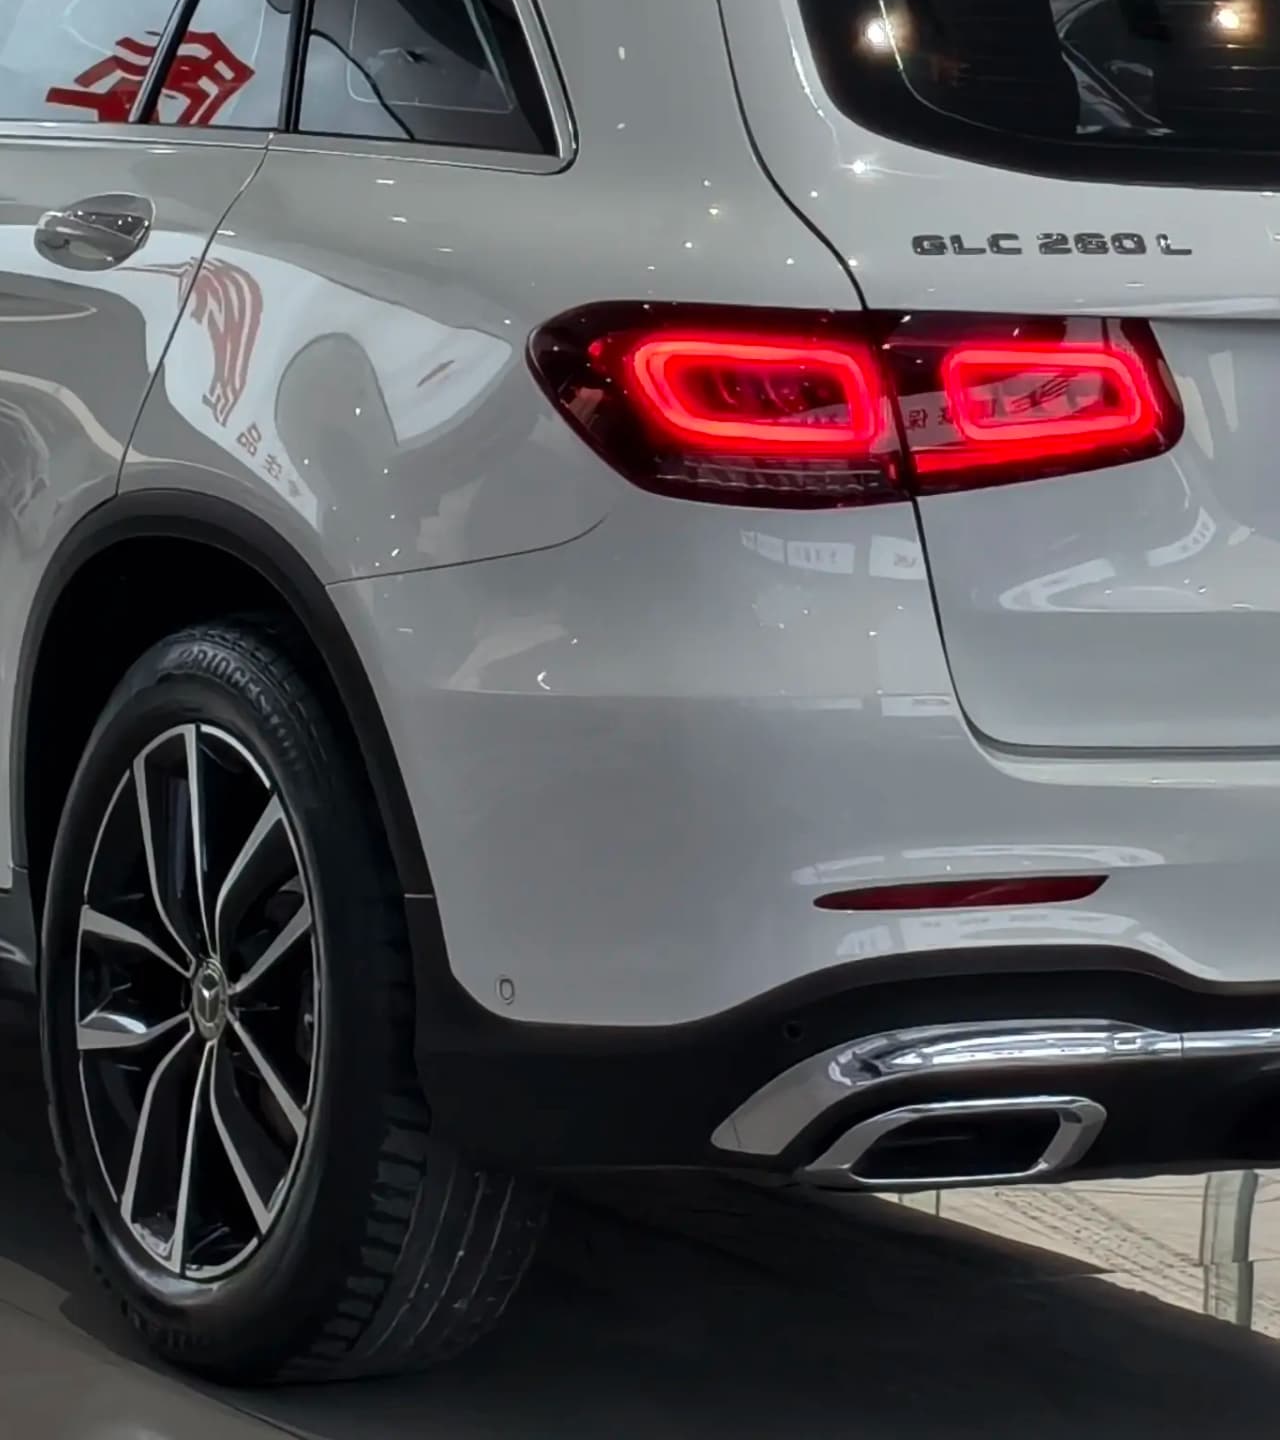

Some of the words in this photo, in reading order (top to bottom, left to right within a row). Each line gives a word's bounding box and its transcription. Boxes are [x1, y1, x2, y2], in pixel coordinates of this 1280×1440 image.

[911, 234, 1022, 256] GLC
[1036, 232, 1148, 256] 260
[1155, 233, 1193, 256] L
